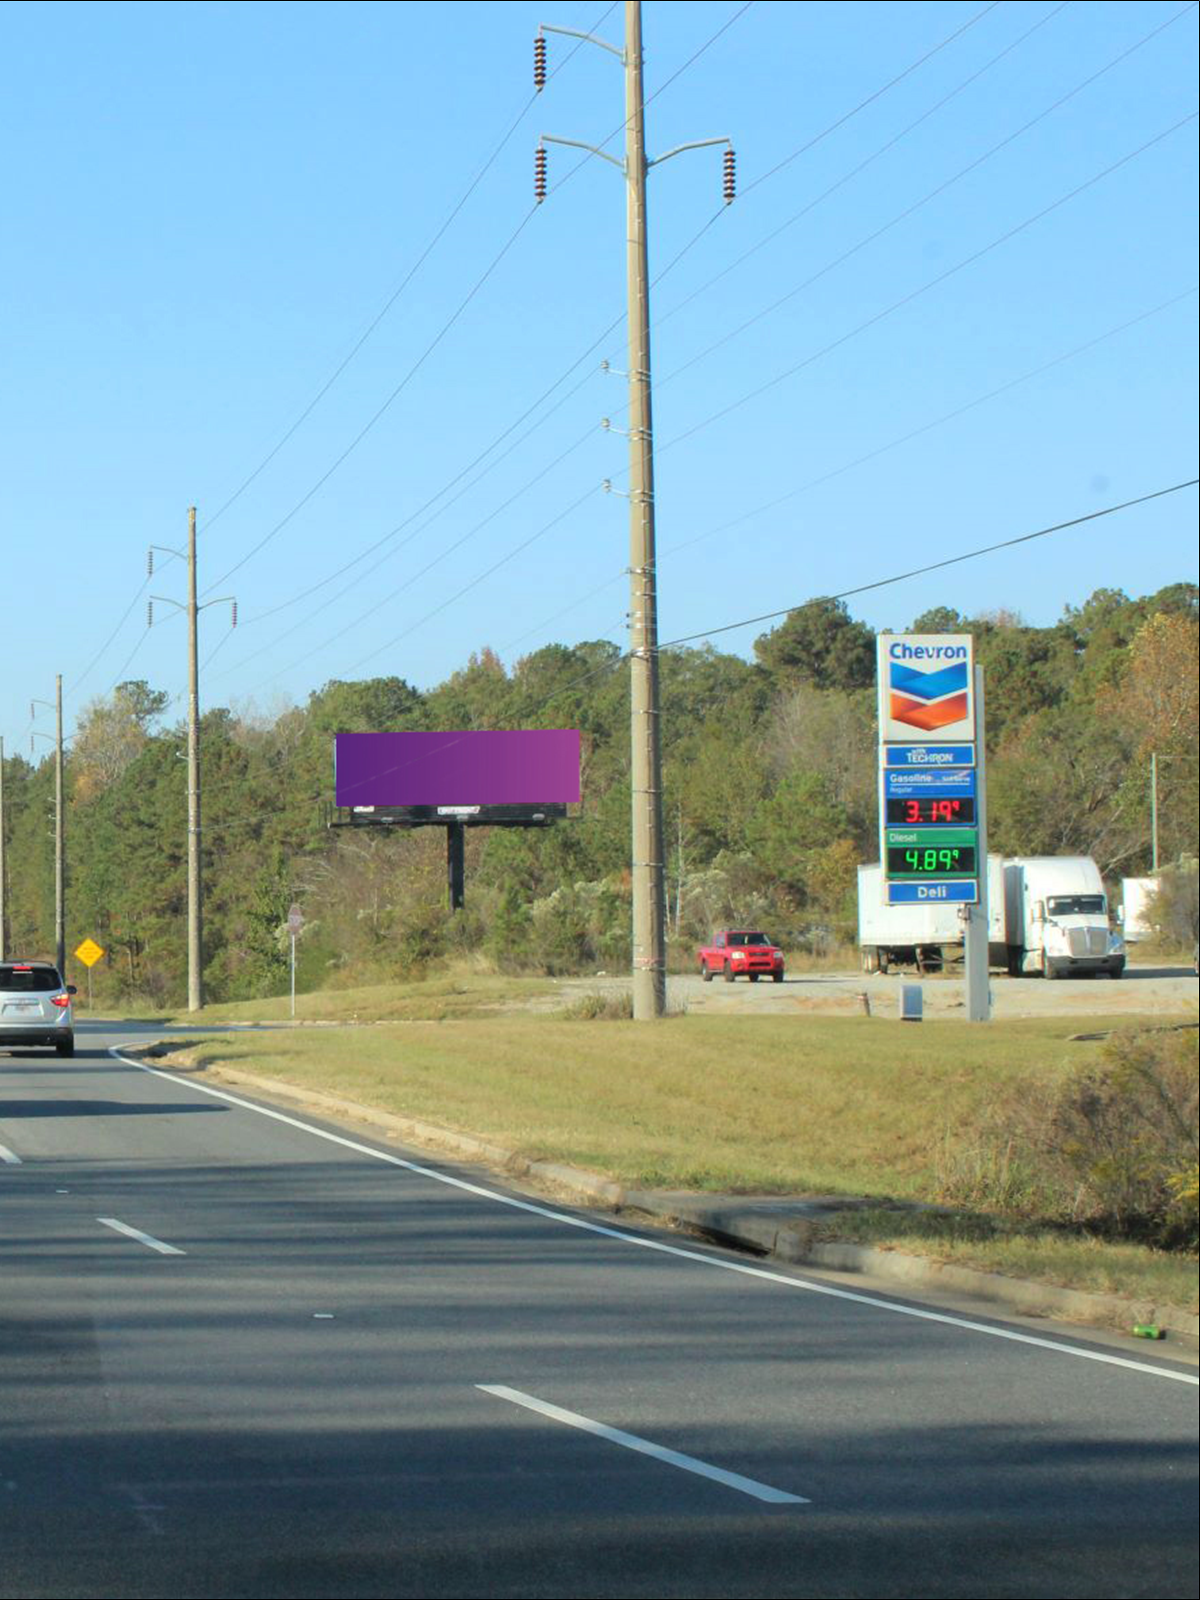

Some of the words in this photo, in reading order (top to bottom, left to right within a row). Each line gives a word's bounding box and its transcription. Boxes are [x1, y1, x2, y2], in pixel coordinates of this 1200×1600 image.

[889, 643, 967, 659] Chevron
[889, 774, 932, 783] Gasoline
[889, 833, 917, 843] Diesel
[917, 887, 947, 898] Deli
